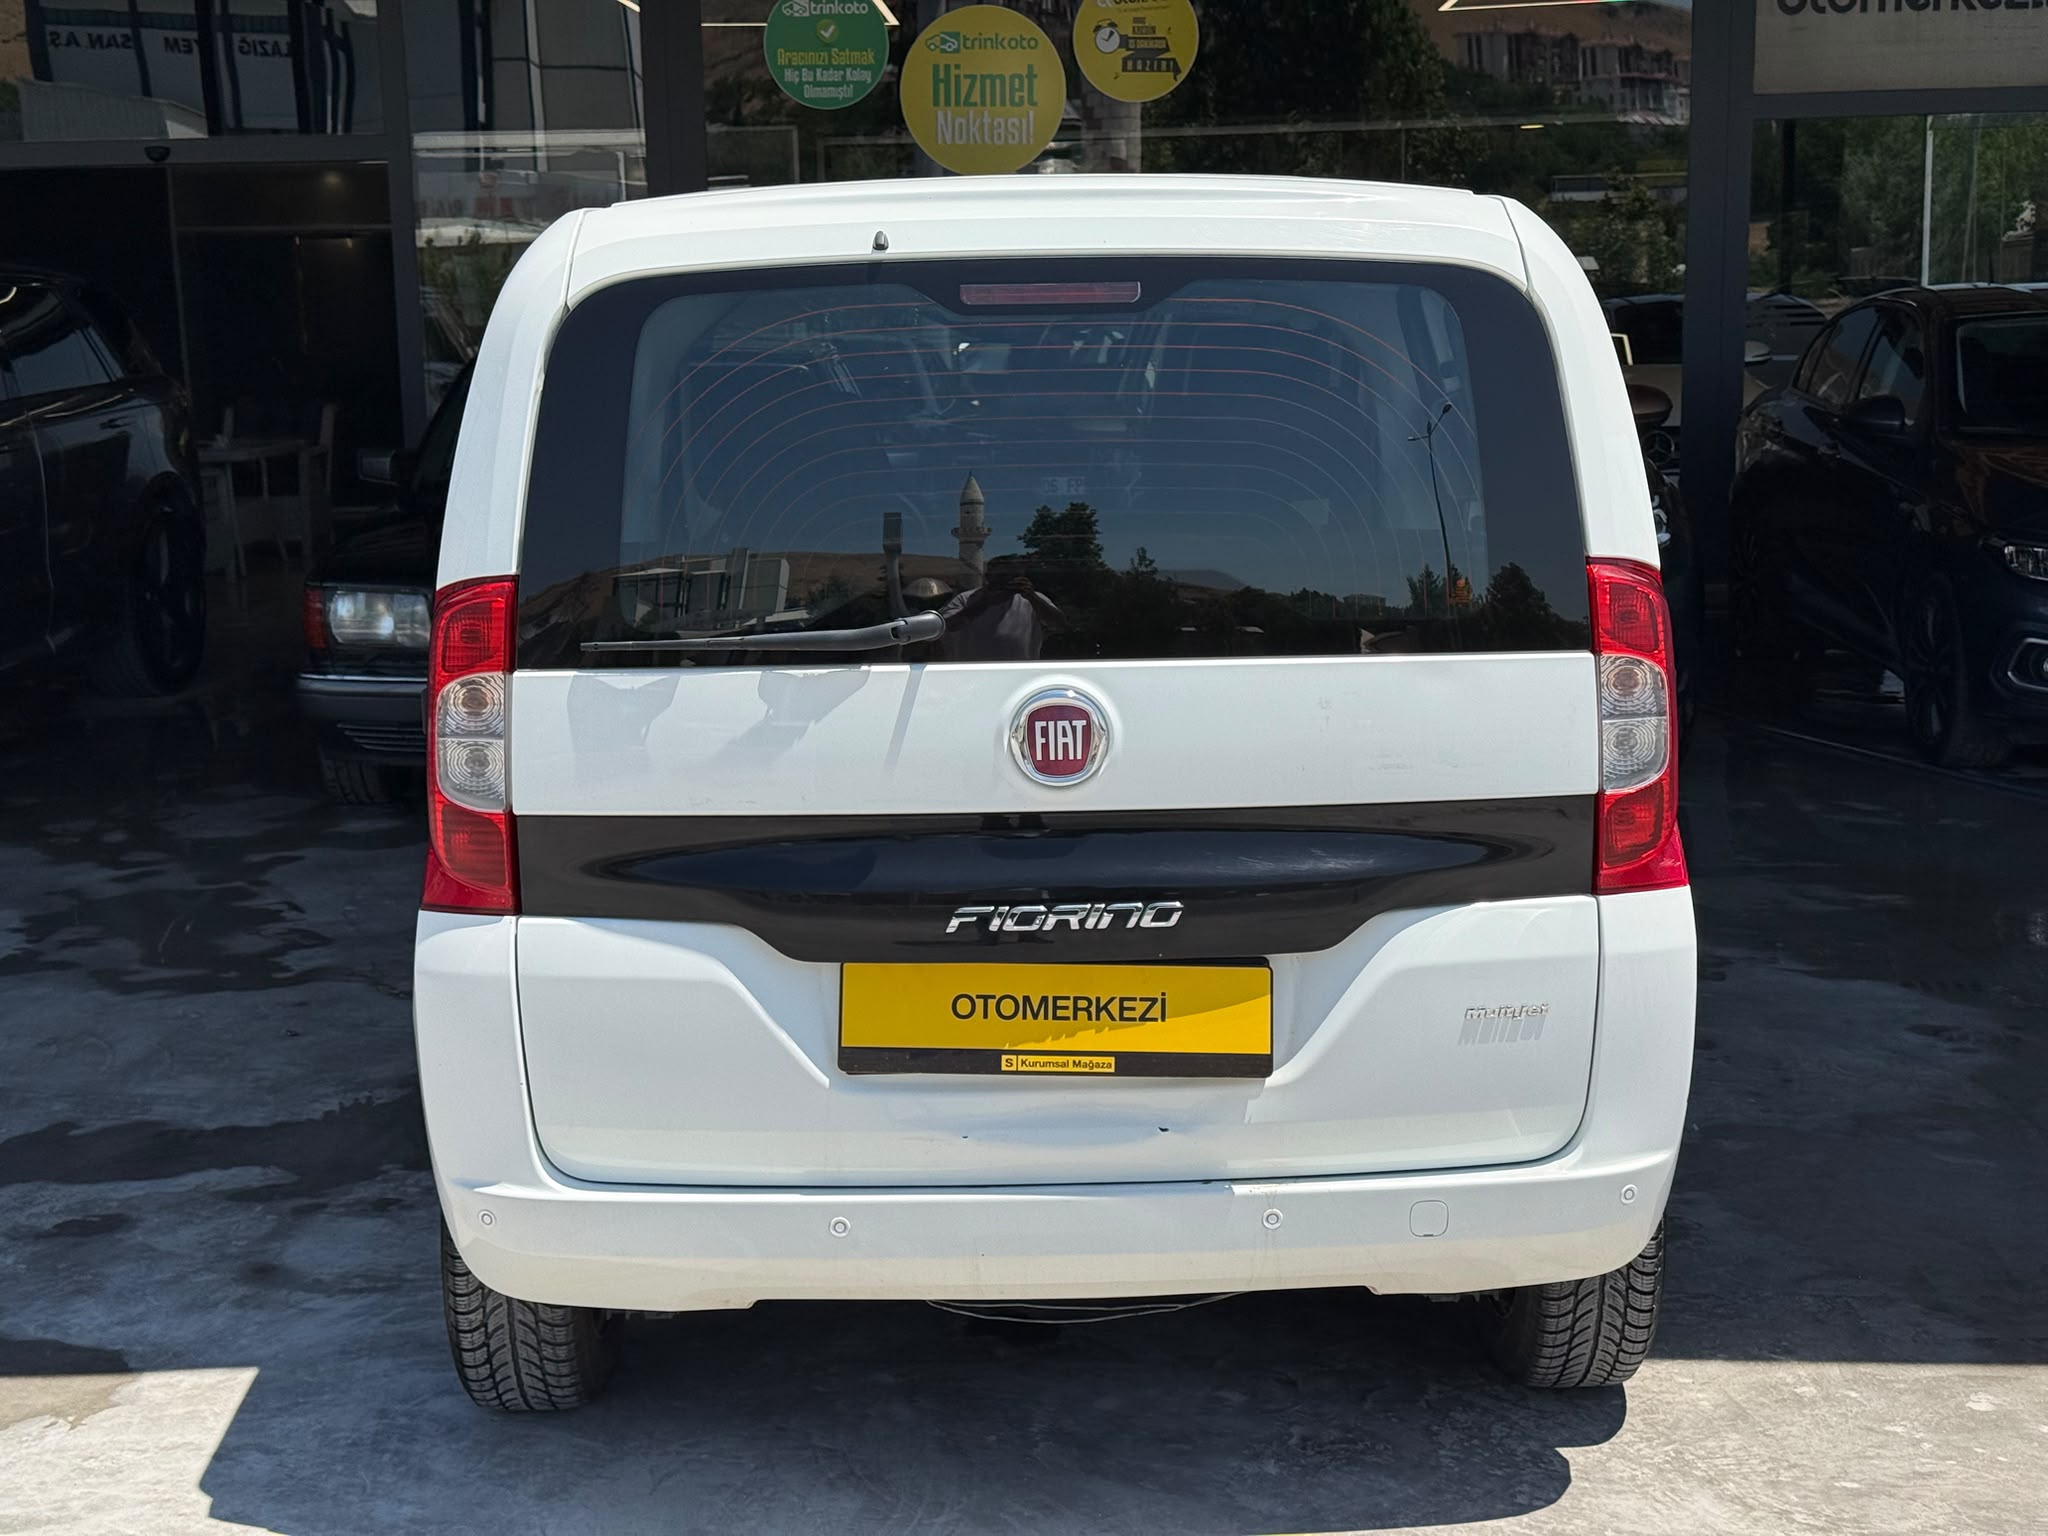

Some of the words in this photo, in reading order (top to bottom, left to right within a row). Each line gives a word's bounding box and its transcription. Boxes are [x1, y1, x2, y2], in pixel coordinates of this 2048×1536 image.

[831, 48, 875, 65] Satmak
[962, 32, 1039, 50] trinkoto
[784, 68, 800, 85] Hiç
[802, 68, 814, 81] Bu
[816, 68, 844, 81] Kadar
[845, 67, 872, 83] Kolay
[932, 63, 1038, 107] Hizmet
[936, 109, 1035, 145] Noktası!
[1034, 720, 1087, 761] FIAT
[946, 901, 1185, 933] FIORINO
[951, 992, 1167, 1023] OTOMERKEZİ
[1005, 1058, 1014, 1068] S
[1020, 1058, 1070, 1069] Kurumsal
[1072, 1059, 1113, 1070] Mağaza
